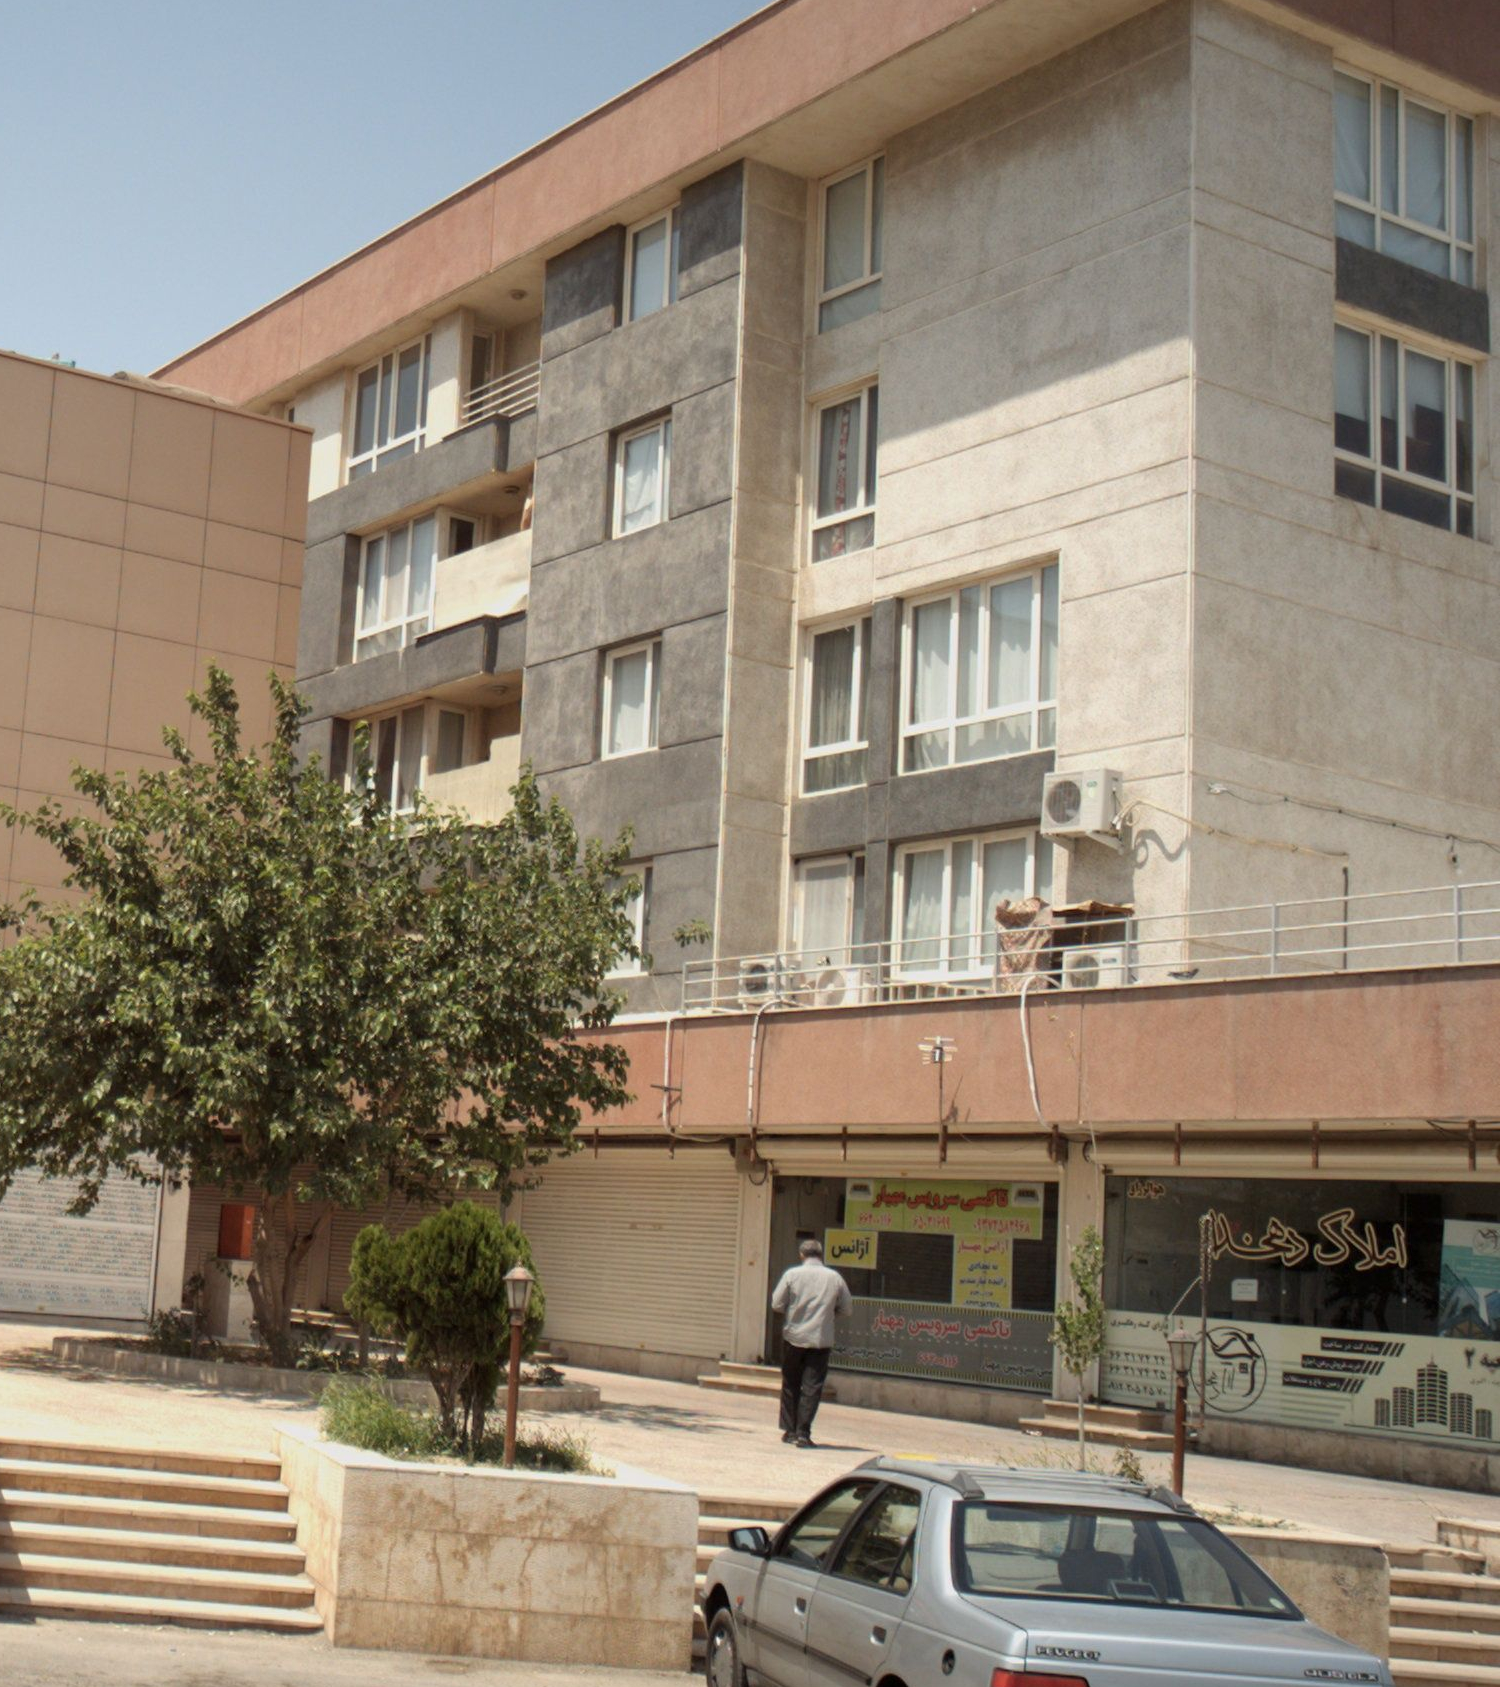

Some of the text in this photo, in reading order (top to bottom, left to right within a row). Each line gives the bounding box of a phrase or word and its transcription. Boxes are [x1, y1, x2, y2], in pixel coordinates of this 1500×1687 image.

[873, 1184, 1009, 1212] تاکسی سرویس مهیار
[831, 1237, 870, 1260] آژانس
[1209, 1207, 1408, 1270] املاک دهخدا
[872, 1310, 1011, 1341] تاکسی سرویس مهیار
[1035, 1645, 1101, 1661] PEUGEOT
